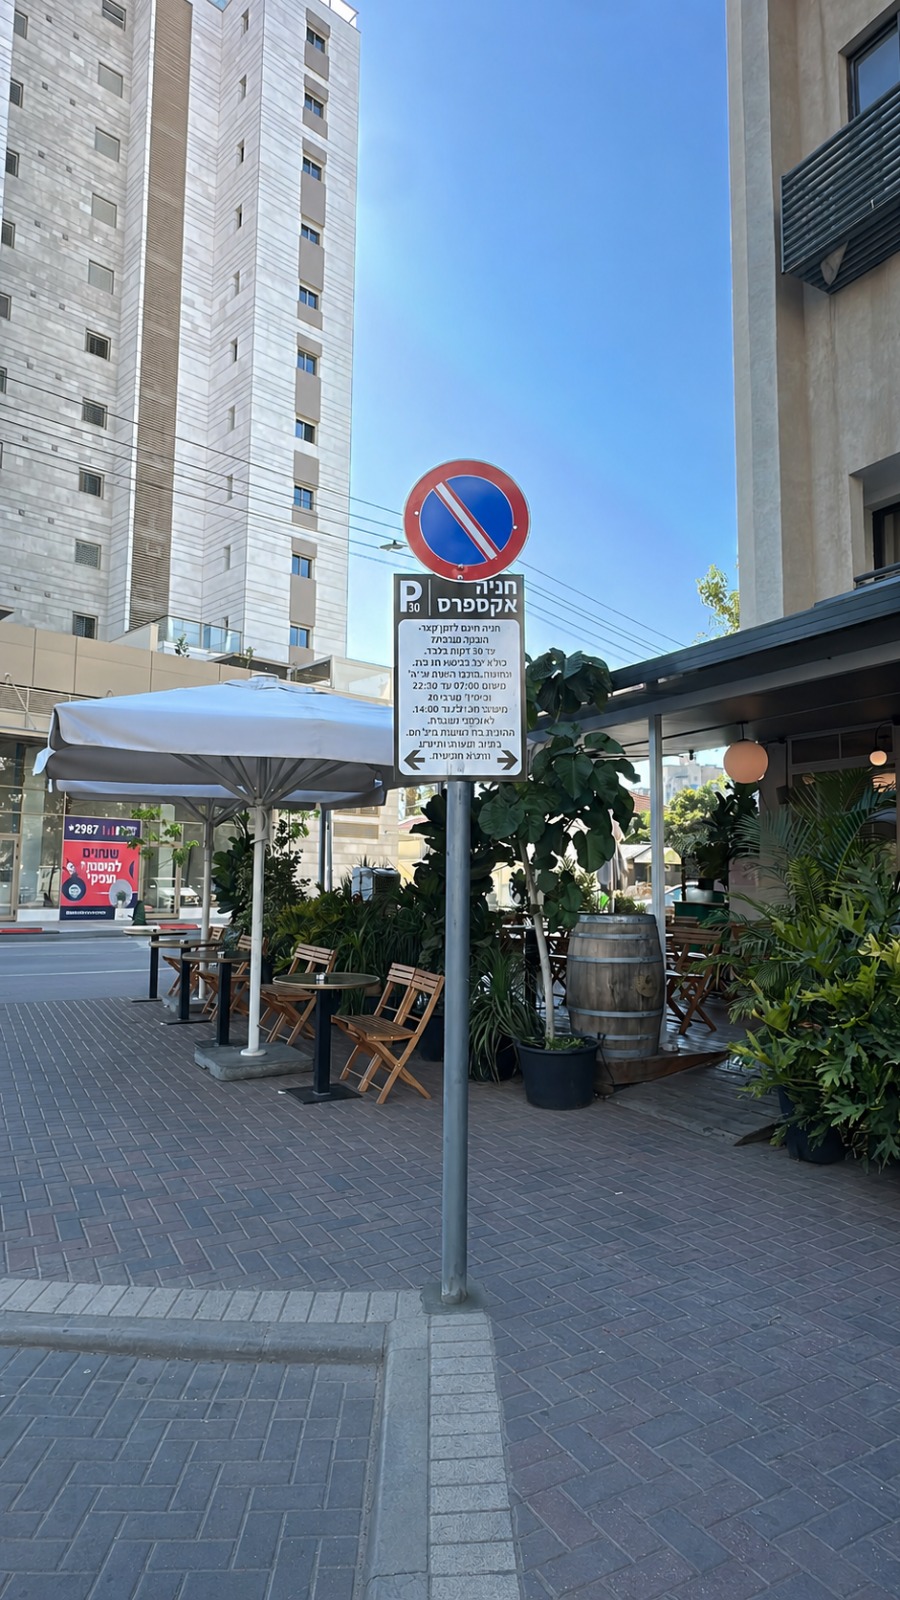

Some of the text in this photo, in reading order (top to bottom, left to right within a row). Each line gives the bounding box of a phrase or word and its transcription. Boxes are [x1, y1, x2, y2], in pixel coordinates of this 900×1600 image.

[476, 580, 517, 594] חניה
[400, 580, 422, 612] P
[408, 602, 420, 612] 30
[437, 598, 517, 617] אקספרס
[482, 624, 501, 633] חניה
[472, 647, 483, 655] 30
[412, 682, 438, 690] 22:30
[440, 682, 452, 690] עד
[453, 682, 480, 690] 07:00
